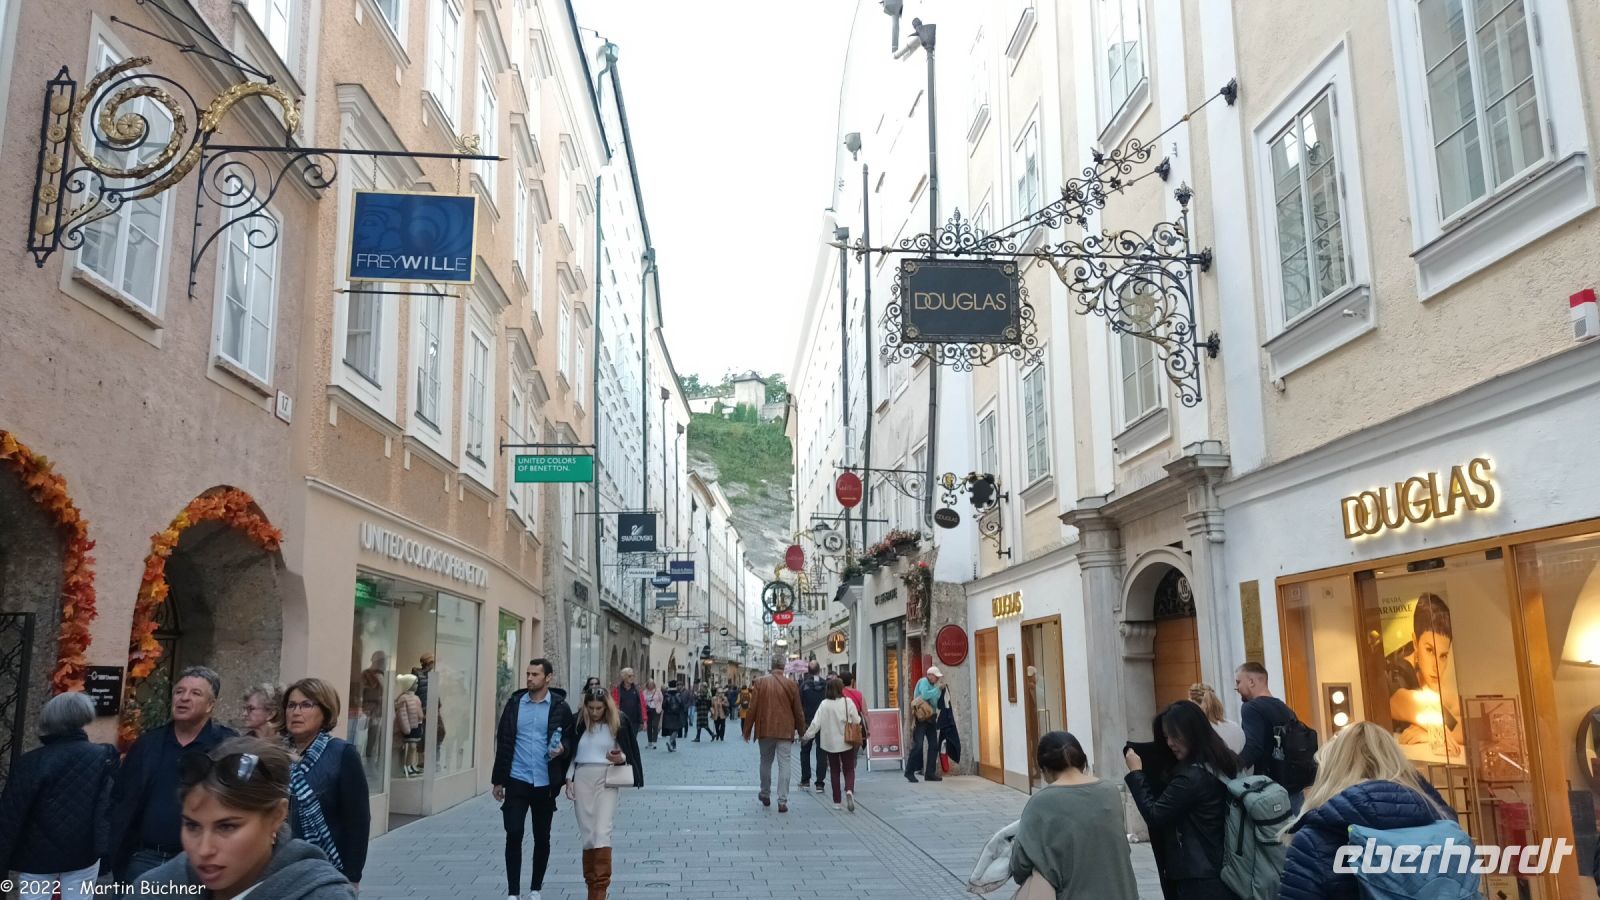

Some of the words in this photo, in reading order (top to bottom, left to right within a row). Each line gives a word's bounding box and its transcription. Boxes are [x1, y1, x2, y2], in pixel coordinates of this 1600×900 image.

[357, 253, 468, 272] FREYWILLE
[914, 292, 1006, 311] DOUGLAS
[282, 395, 289, 411] 17
[518, 457, 546, 465] UNITED
[547, 457, 577, 465] COLORS
[1341, 457, 1495, 539] DOUGLAS
[936, 513, 959, 523] DOUGLAS
[361, 521, 404, 558] UNITED
[405, 540, 443, 571] COLORS
[1180, 578, 1188, 595] 16
